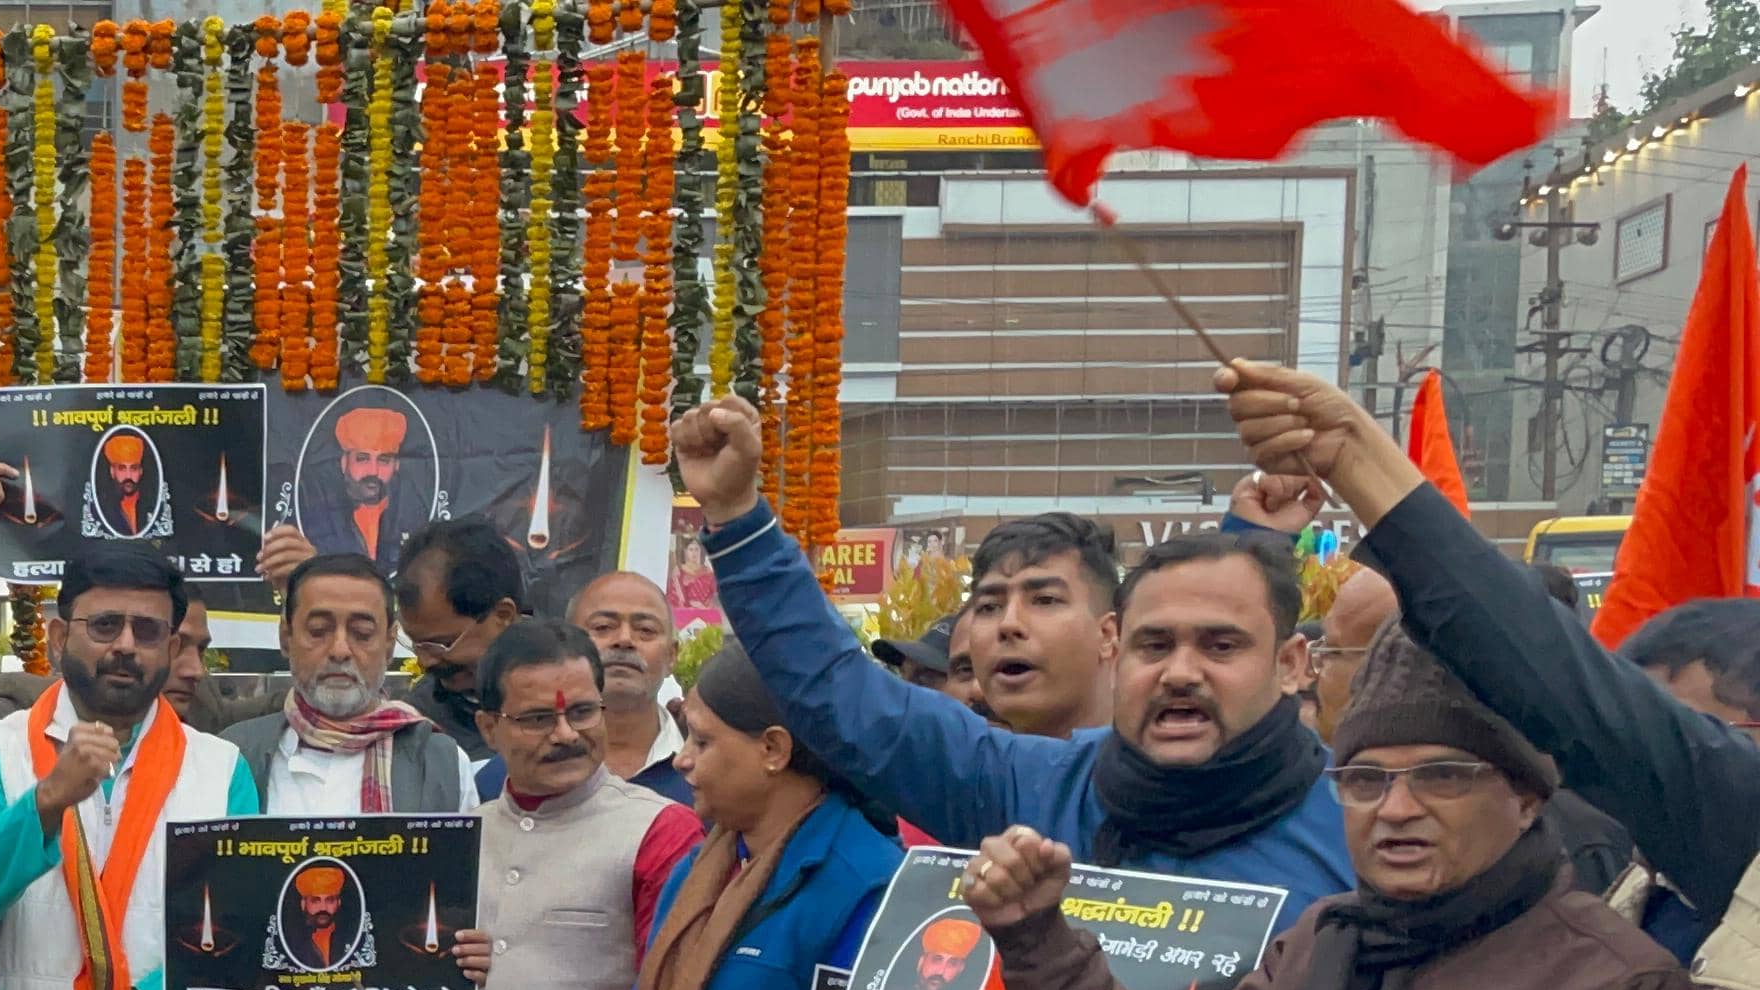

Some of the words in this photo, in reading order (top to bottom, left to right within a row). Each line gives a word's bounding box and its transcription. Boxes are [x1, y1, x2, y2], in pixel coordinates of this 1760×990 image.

[847, 71, 930, 103] punjab
[932, 71, 1010, 96] nation
[931, 107, 944, 118] of
[945, 108, 972, 118] India
[974, 108, 1024, 118] Undertak
[938, 134, 988, 145] Ranchi
[991, 134, 1040, 145] Branc
[52, 404, 113, 431] भावपूर्ण
[117, 404, 197, 426] श्रद्धांजली
[12, 560, 66, 577] हत्या
[190, 555, 213, 573] से
[217, 554, 243, 574] हो
[818, 544, 877, 565] AREE
[238, 836, 309, 863] भावपूर्ण
[312, 835, 405, 858] श्रद्धांजली
